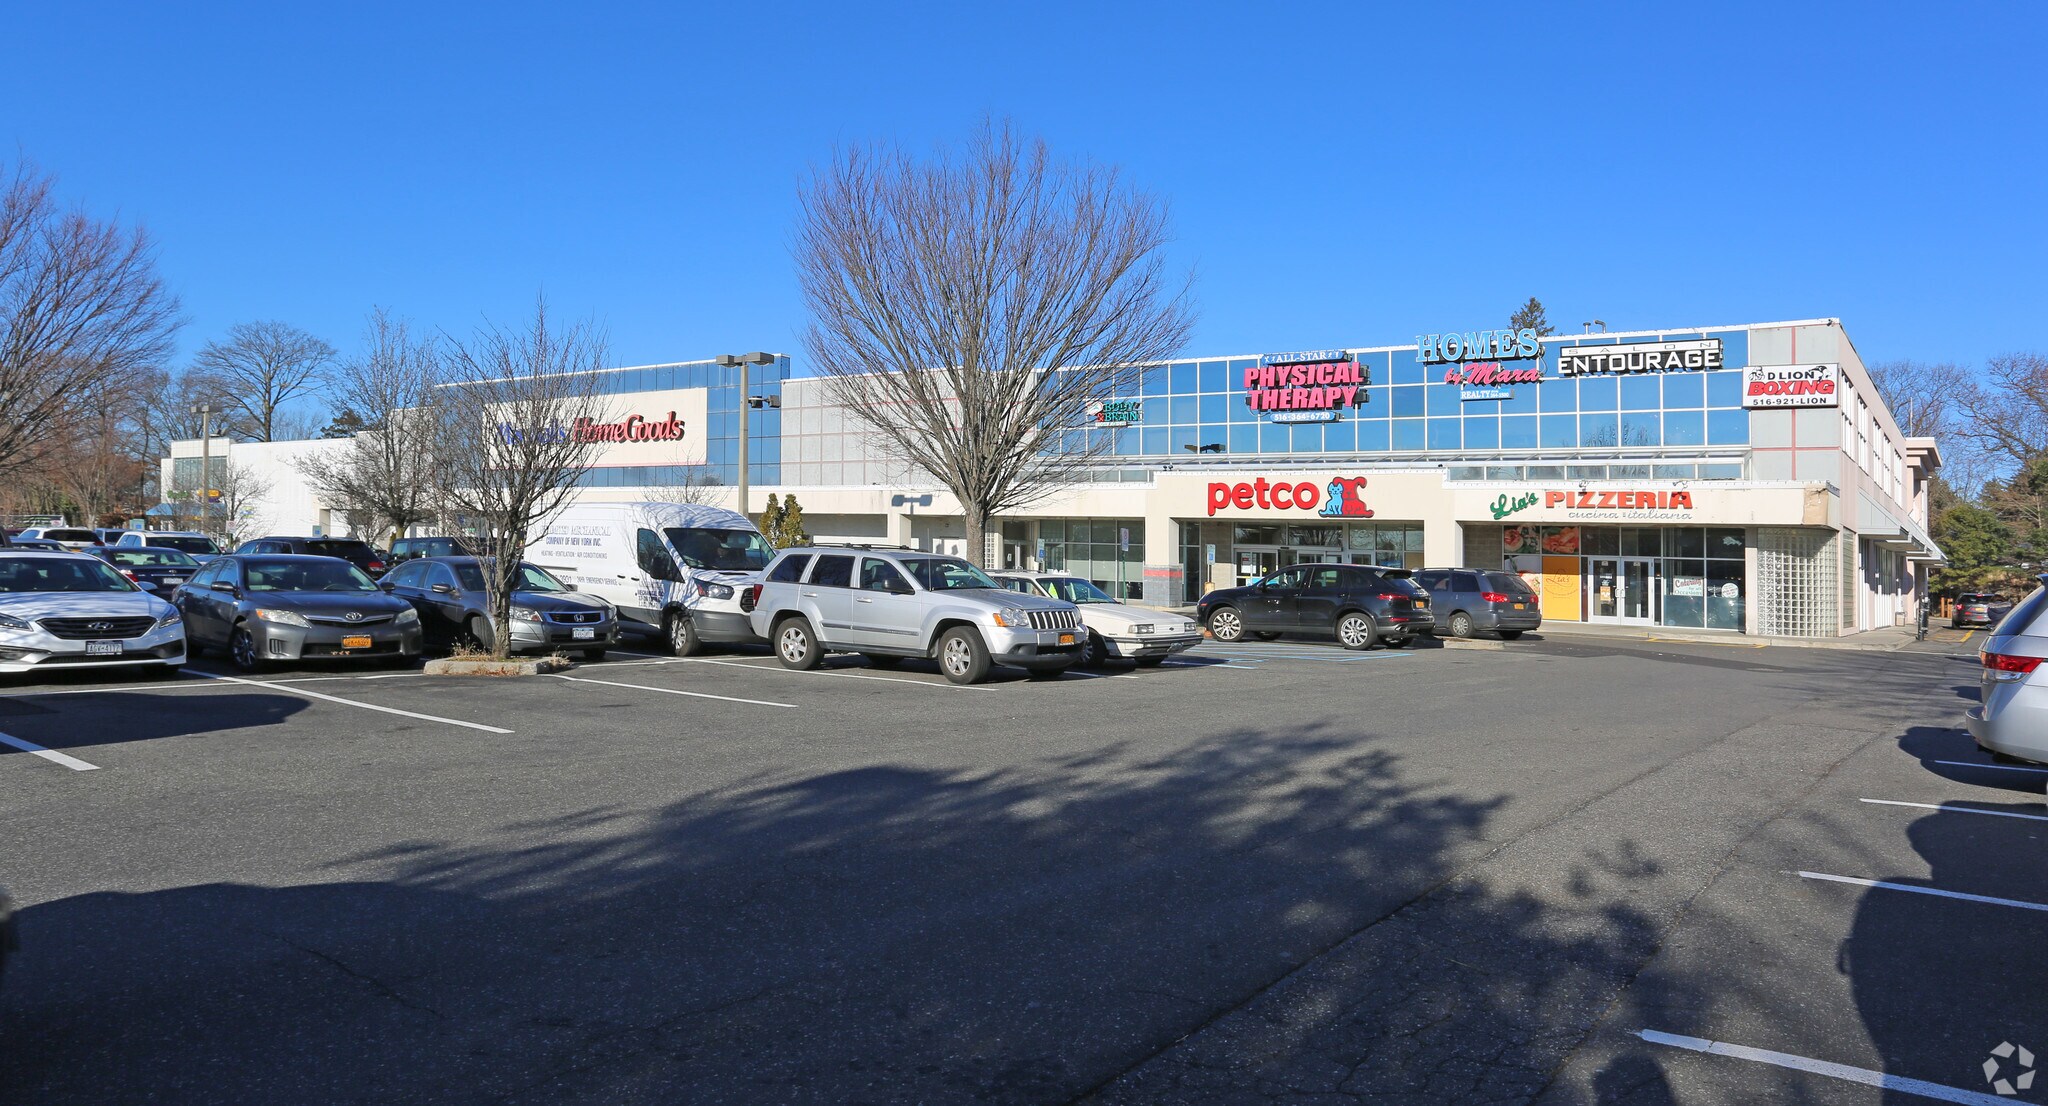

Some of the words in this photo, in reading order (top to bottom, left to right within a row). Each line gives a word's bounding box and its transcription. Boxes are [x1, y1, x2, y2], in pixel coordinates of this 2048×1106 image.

[1415, 328, 1540, 362] HOMES
[1569, 342, 1711, 354] SALON
[1276, 351, 1327, 362] ALL-STAR
[1558, 350, 1720, 374] ENTOURAGE
[1244, 362, 1364, 388] PHYSICAL
[1444, 368, 1463, 385] by
[1464, 362, 1540, 385] Mara
[1768, 372, 1775, 380] D
[1779, 371, 1814, 380] LION
[1461, 390, 1490, 399] REALTY
[1747, 380, 1835, 396] BOXING
[1247, 386, 1359, 410] THERAPY
[1105, 412, 1138, 422] BRAIN
[573, 411, 684, 443] HomeGoods
[1208, 477, 1320, 516] petco
[1490, 491, 1539, 520] Lia's
[1545, 491, 1693, 509] PIZZERIA
[1568, 510, 1618, 519] cucina
[1628, 509, 1692, 520] italiana
[546, 537, 564, 545] COMPANY
